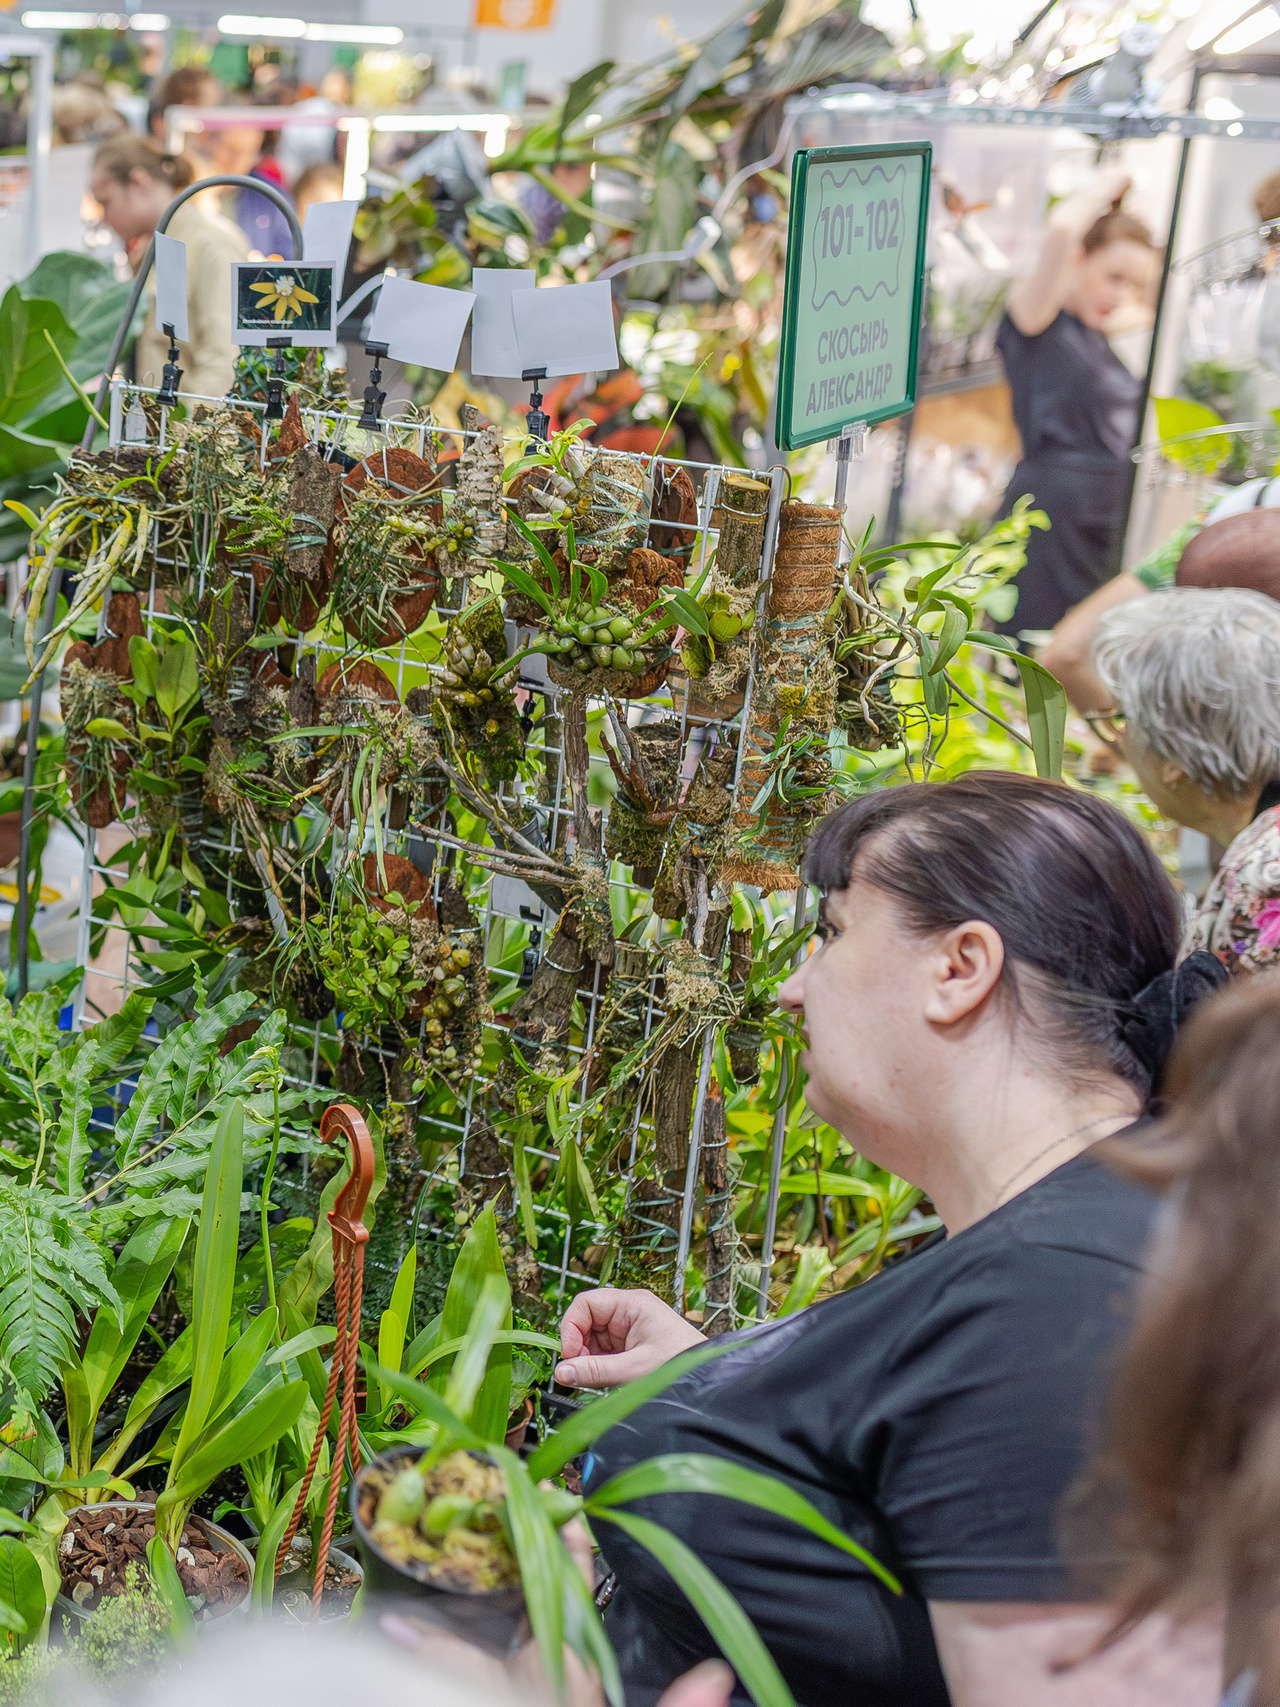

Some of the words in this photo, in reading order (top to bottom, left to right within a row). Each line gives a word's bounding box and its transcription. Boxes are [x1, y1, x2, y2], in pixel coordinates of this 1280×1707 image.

[822, 199, 899, 258] 101-102
[818, 320, 888, 363] СКОСЫРЬ
[807, 364, 892, 415] АЛЕКСАНДР
